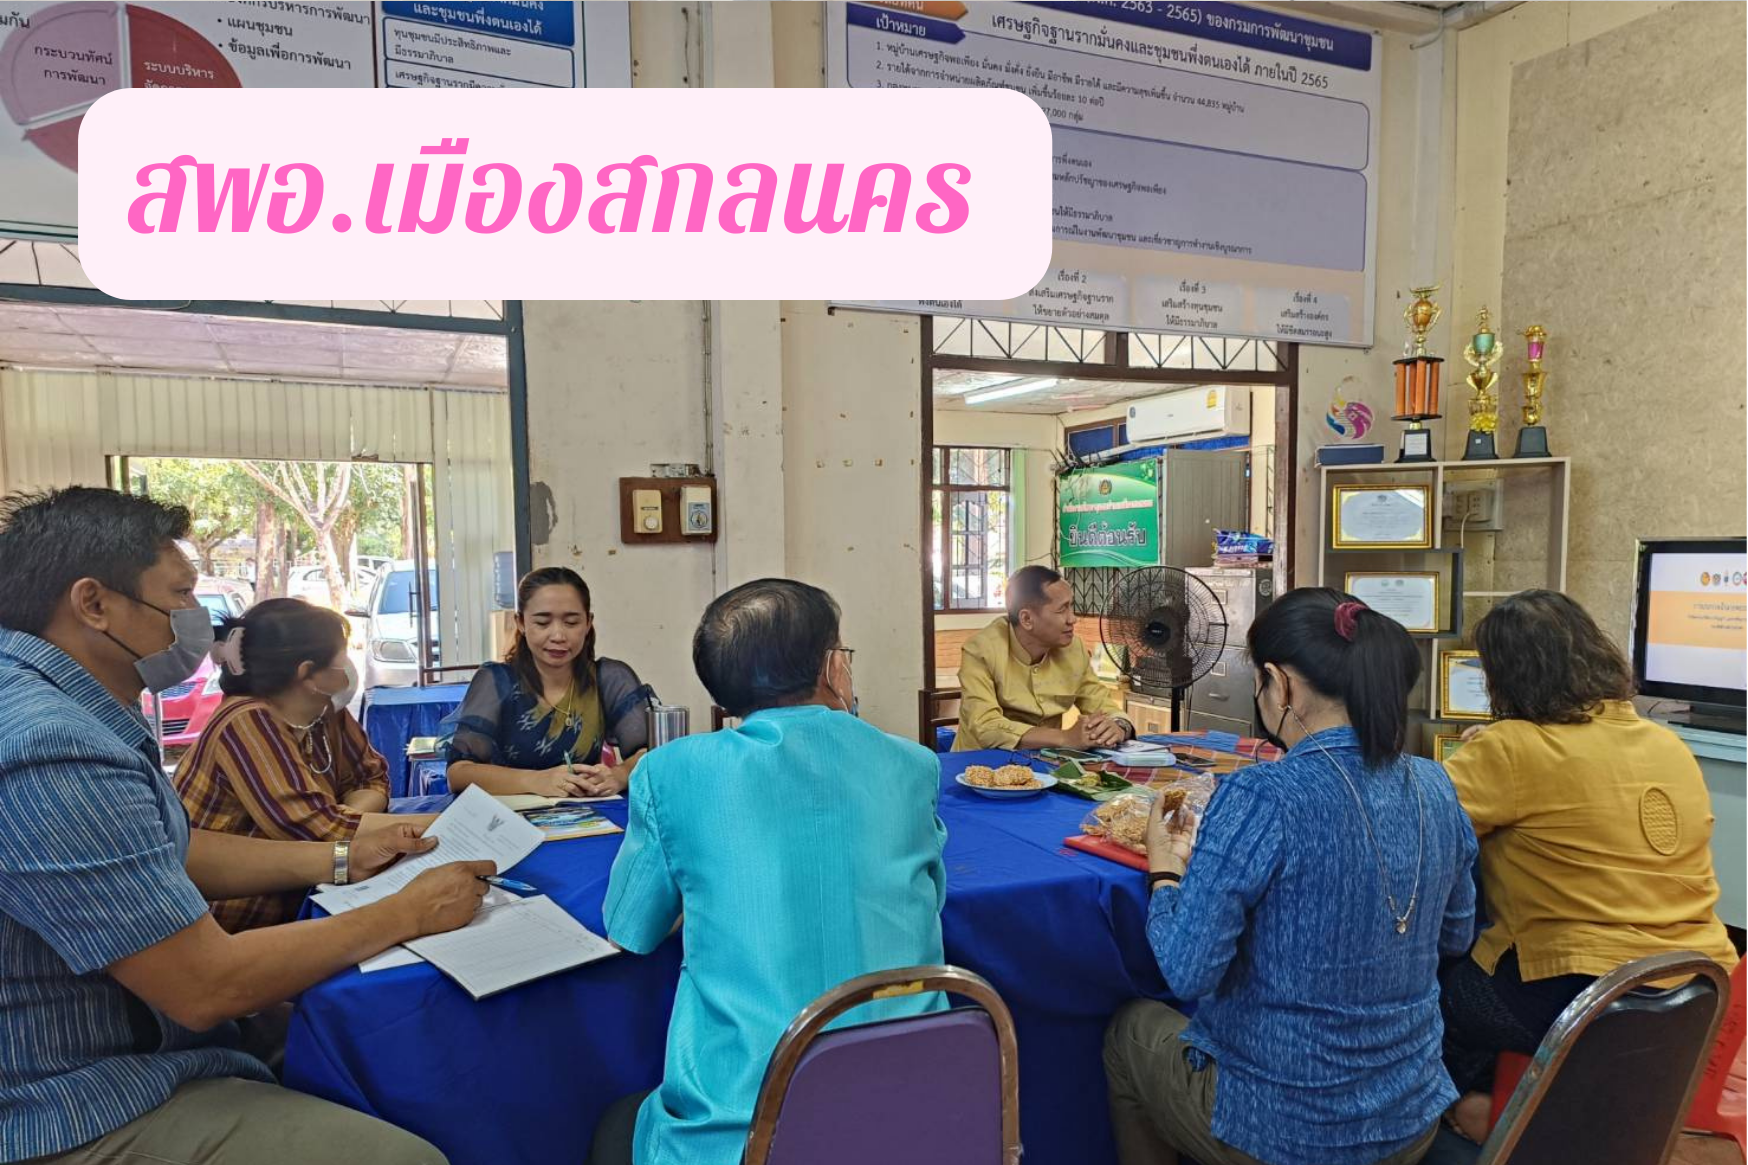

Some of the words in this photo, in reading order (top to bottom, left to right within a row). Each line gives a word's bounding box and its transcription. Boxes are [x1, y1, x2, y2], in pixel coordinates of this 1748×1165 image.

[227, 16, 293, 37] แผนชุมชน
[413, 3, 543, 36] และชุมชนพึ่งตนเองได้
[875, 13, 926, 37] เป้าหมาย
[1166, 4, 1202, 26] 2565)
[1206, 12, 1334, 51] ของกรมการพัฒนาชุมชน
[228, 37, 351, 70] ข้อมูลเพื่อการพัฒนา
[394, 28, 512, 57] ทุนชุมชนมีประสิทธิภาพและ
[876, 41, 885, 51] 1.
[34, 44, 113, 66] กระบวนทัศน์
[394, 45, 454, 64] มีธรรมาภิบาล
[44, 69, 106, 86] การพัฒนา
[144, 60, 214, 80] ระบบบริหาร
[1254, 62, 1297, 84] ภายในปี
[1301, 72, 1329, 89] 2565
[1081, 274, 1088, 284] 2
